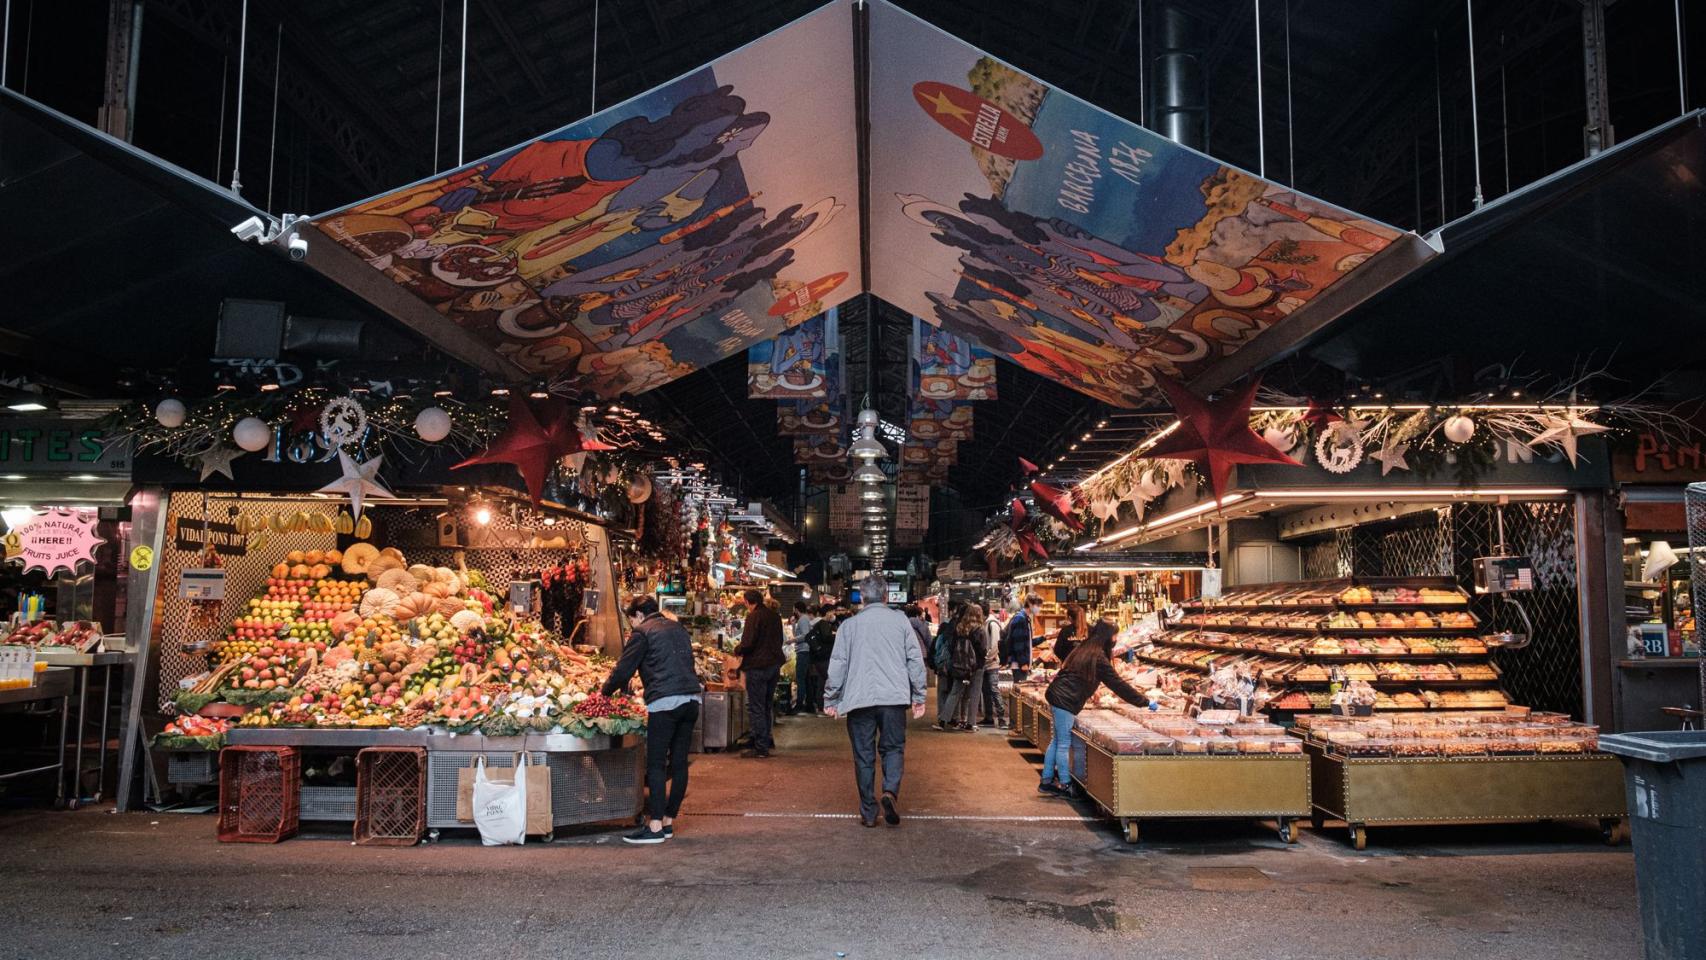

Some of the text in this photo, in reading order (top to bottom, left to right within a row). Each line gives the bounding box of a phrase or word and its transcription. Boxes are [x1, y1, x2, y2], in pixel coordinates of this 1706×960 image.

[971, 103, 1001, 149] ESTRELLA
[44, 521, 84, 539] NATURAL
[208, 529, 228, 545] PONS
[23, 547, 52, 560] FRUITS
[55, 548, 80, 560] JUICE
